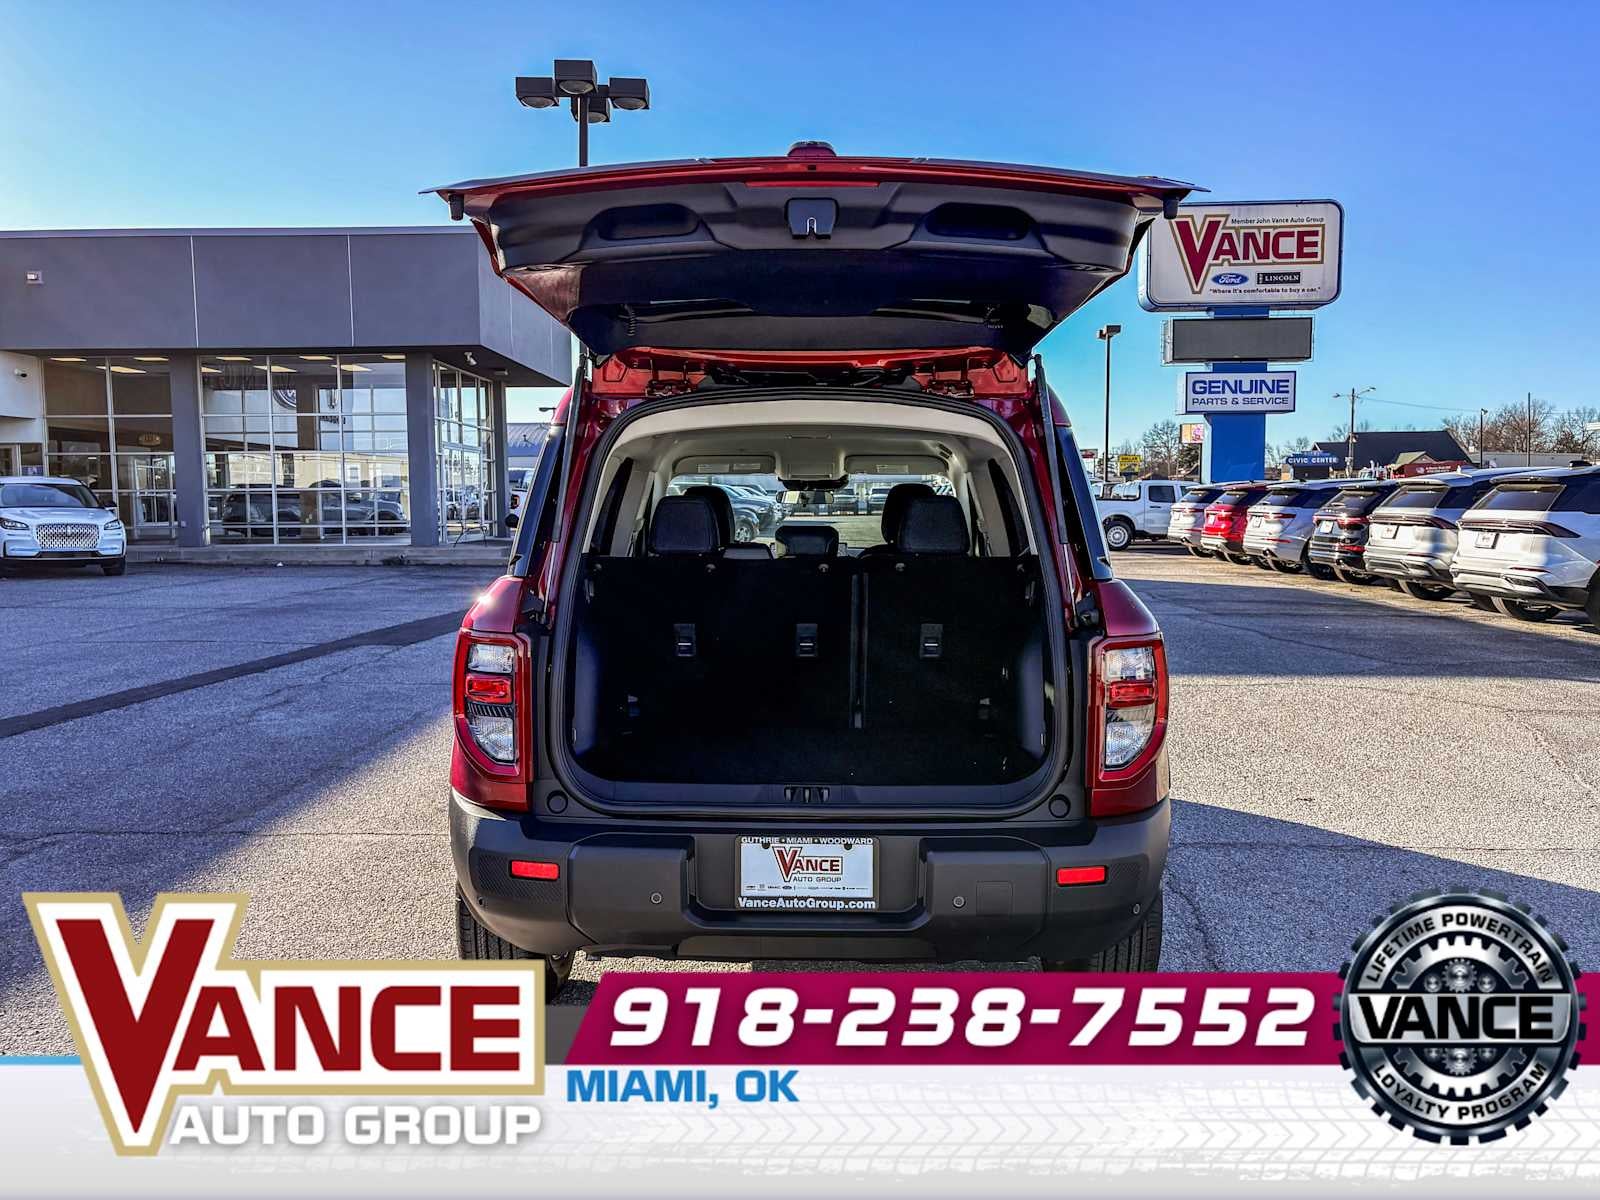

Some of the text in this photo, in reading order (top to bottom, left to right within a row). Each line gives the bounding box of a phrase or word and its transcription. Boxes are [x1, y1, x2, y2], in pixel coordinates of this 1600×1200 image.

[1306, 216, 1325, 224] Group
[1175, 219, 1319, 287] VANCE
[1218, 274, 1242, 284] Ford
[1264, 274, 1299, 282] LINCOLN
[1192, 379, 1290, 395] GENUINE
[1192, 396, 1289, 406] PARTS & SERVICE
[741, 836, 779, 844] GUTHRIE
[819, 837, 873, 845] WOODWARD
[775, 848, 841, 879] VANCE
[738, 896, 876, 911] VanceAutoGroup.com
